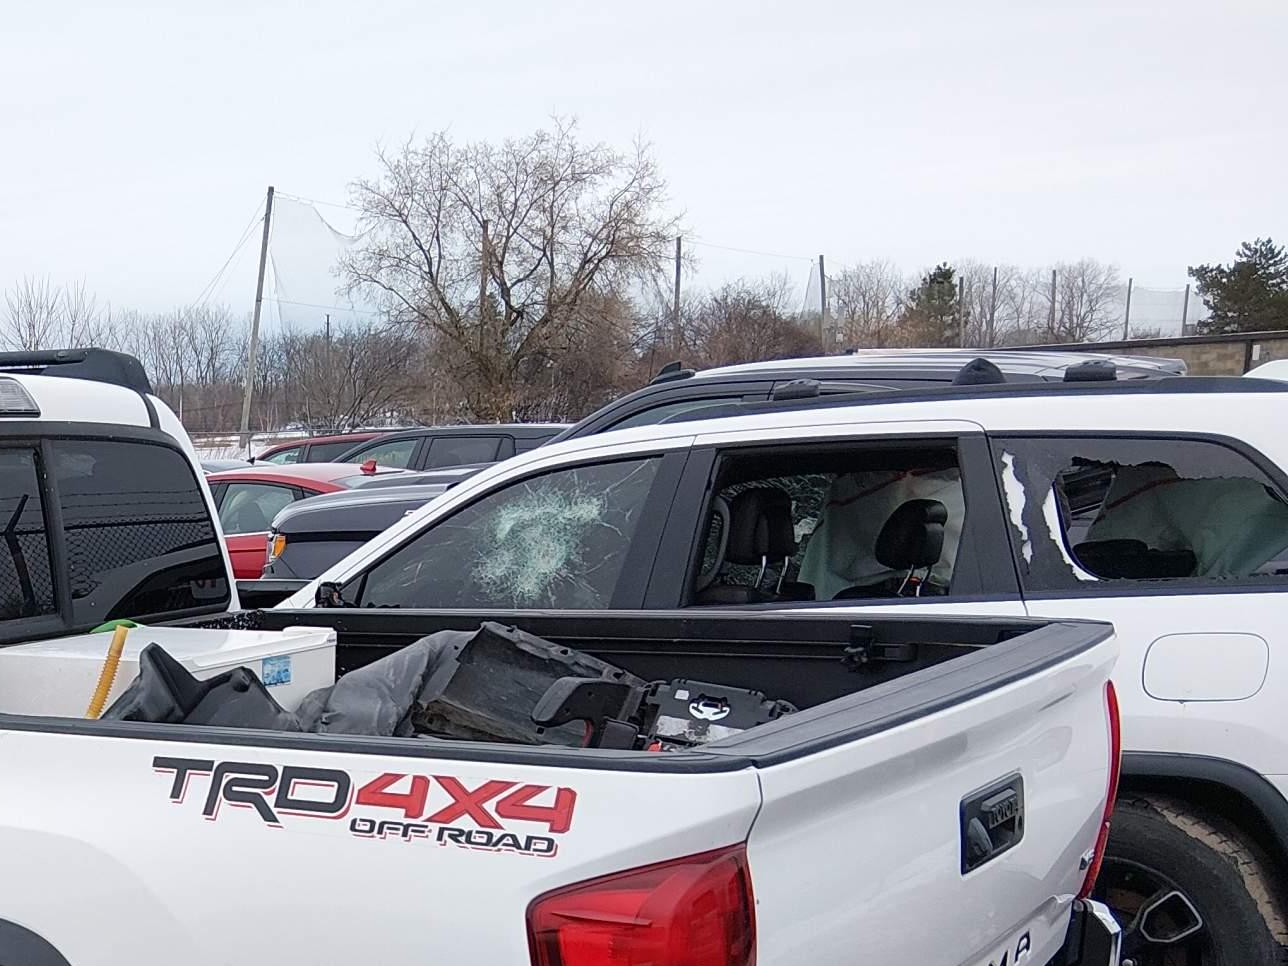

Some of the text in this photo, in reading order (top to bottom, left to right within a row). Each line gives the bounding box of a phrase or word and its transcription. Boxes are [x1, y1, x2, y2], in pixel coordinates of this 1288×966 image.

[152, 756, 353, 827] TRD
[349, 815, 558, 857] OFF ROAD
